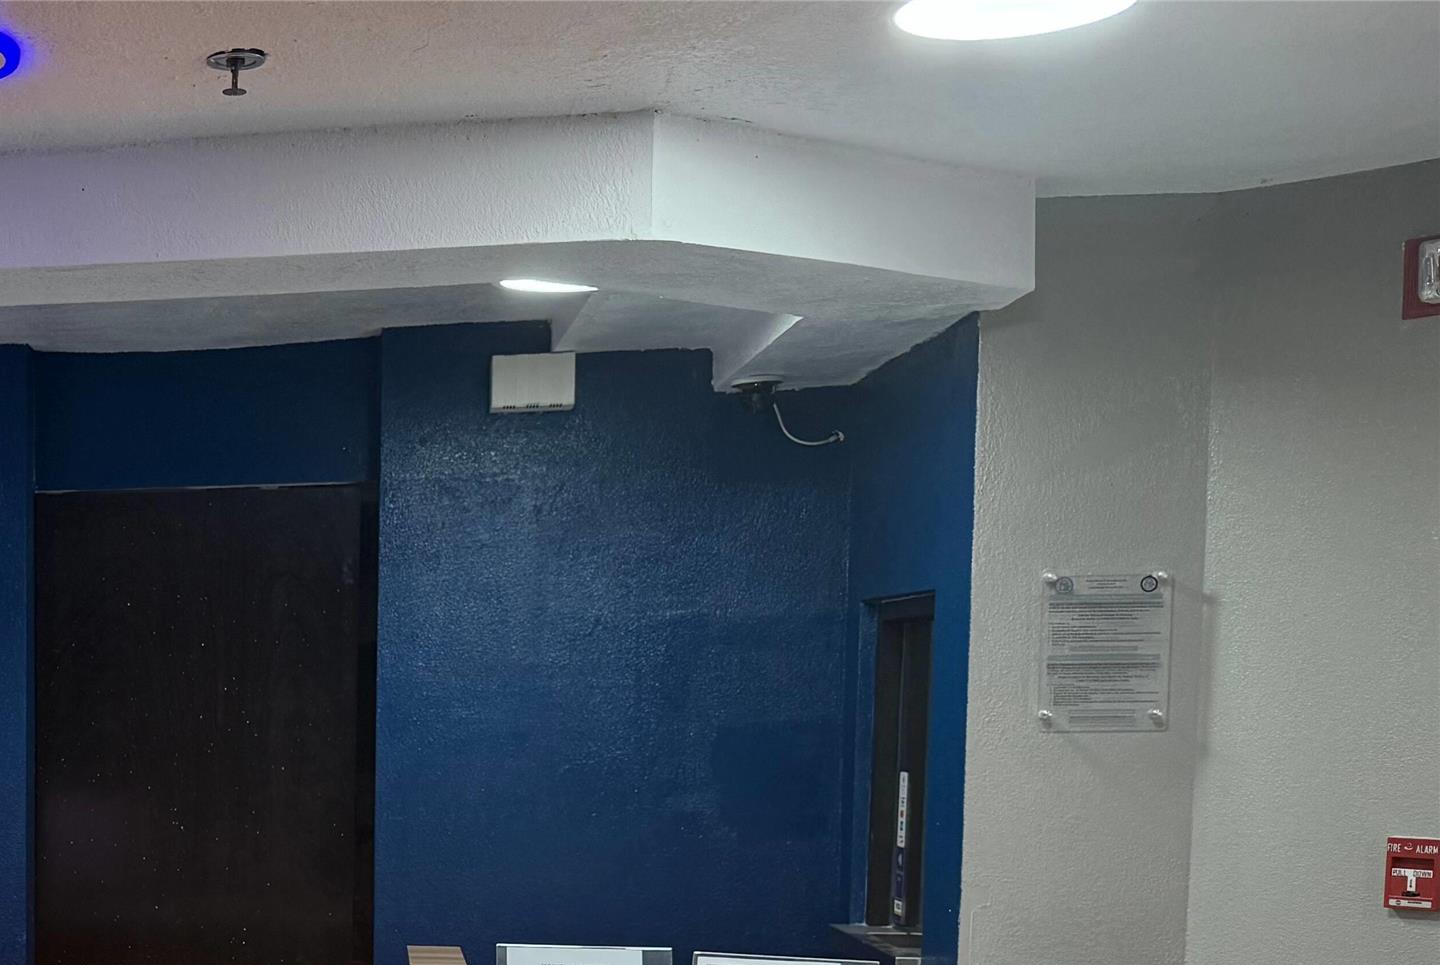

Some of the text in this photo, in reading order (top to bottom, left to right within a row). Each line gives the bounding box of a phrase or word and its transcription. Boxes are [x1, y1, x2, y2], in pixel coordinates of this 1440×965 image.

[1387, 842, 1439, 854] FIRE ALARM
[1392, 869, 1432, 878] PULL DOWN
